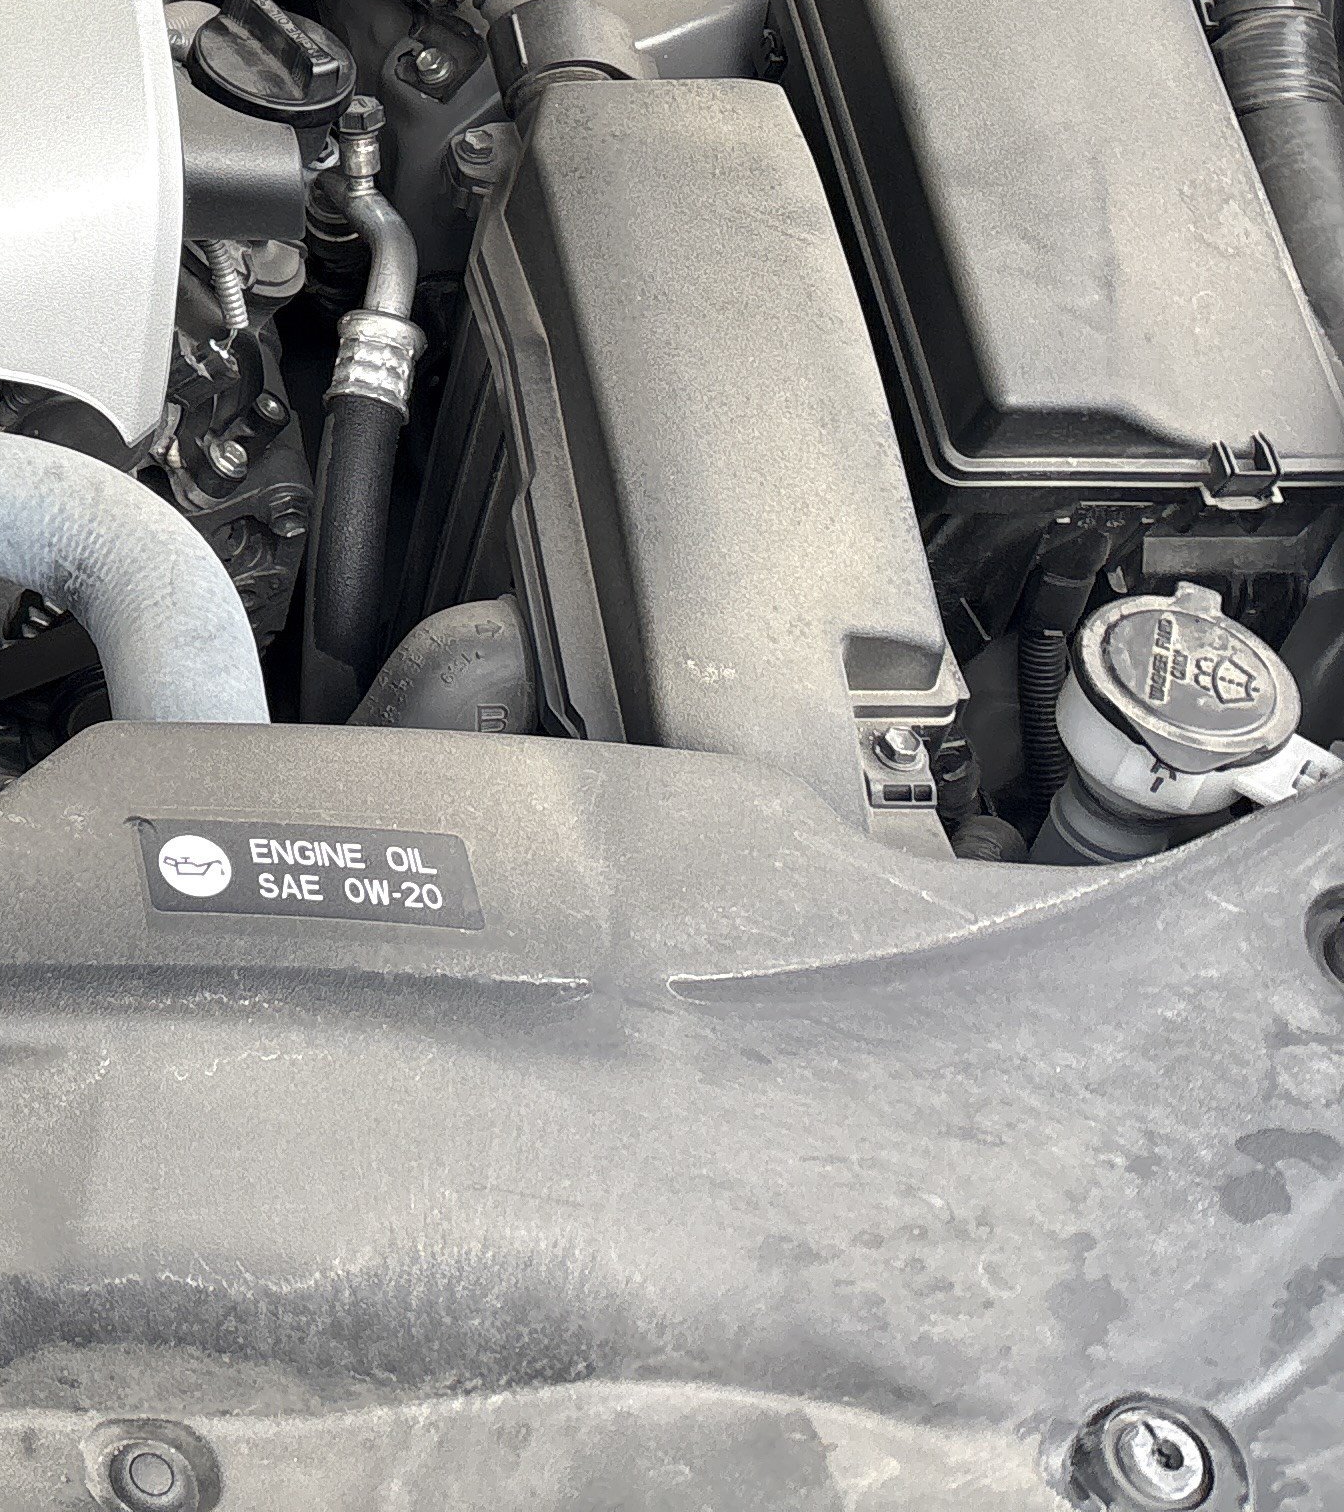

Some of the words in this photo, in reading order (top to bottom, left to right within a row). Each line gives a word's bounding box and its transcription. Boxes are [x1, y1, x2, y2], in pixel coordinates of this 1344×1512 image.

[249, 838, 366, 869] ENGINE
[385, 846, 439, 875] OIL
[257, 873, 325, 901] SAE
[344, 881, 444, 910] 0W-20
